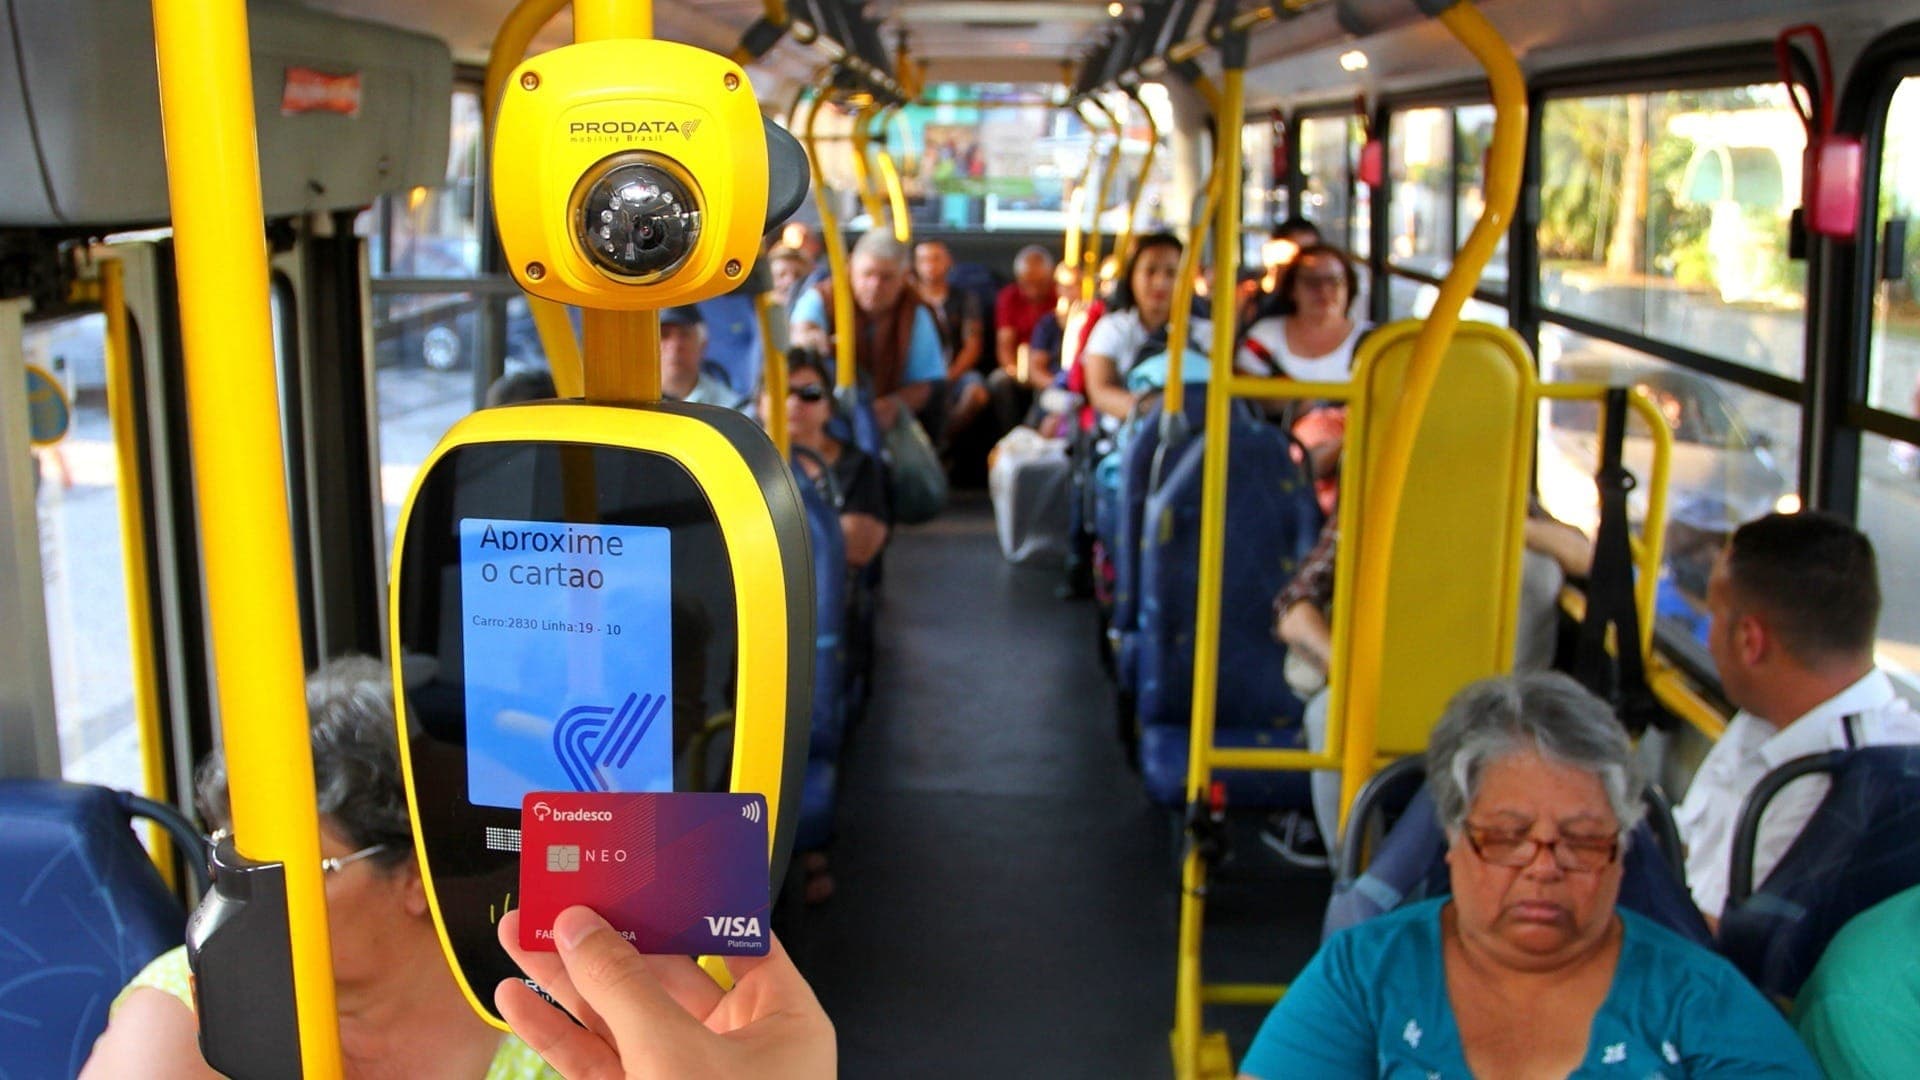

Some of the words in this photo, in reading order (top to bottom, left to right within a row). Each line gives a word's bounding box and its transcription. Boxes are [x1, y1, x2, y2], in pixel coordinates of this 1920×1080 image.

[570, 121, 679, 134] PRODATA
[570, 135, 619, 143] mobility
[480, 524, 623, 557] Aproxime
[481, 563, 498, 582] o
[509, 563, 604, 589] cartao
[472, 615, 538, 630] Carro:2830
[541, 620, 593, 634] Linha:19
[606, 624, 621, 635] 10
[553, 808, 612, 821] bradesco
[704, 916, 761, 937] VISA
[727, 939, 762, 948] Platinum
